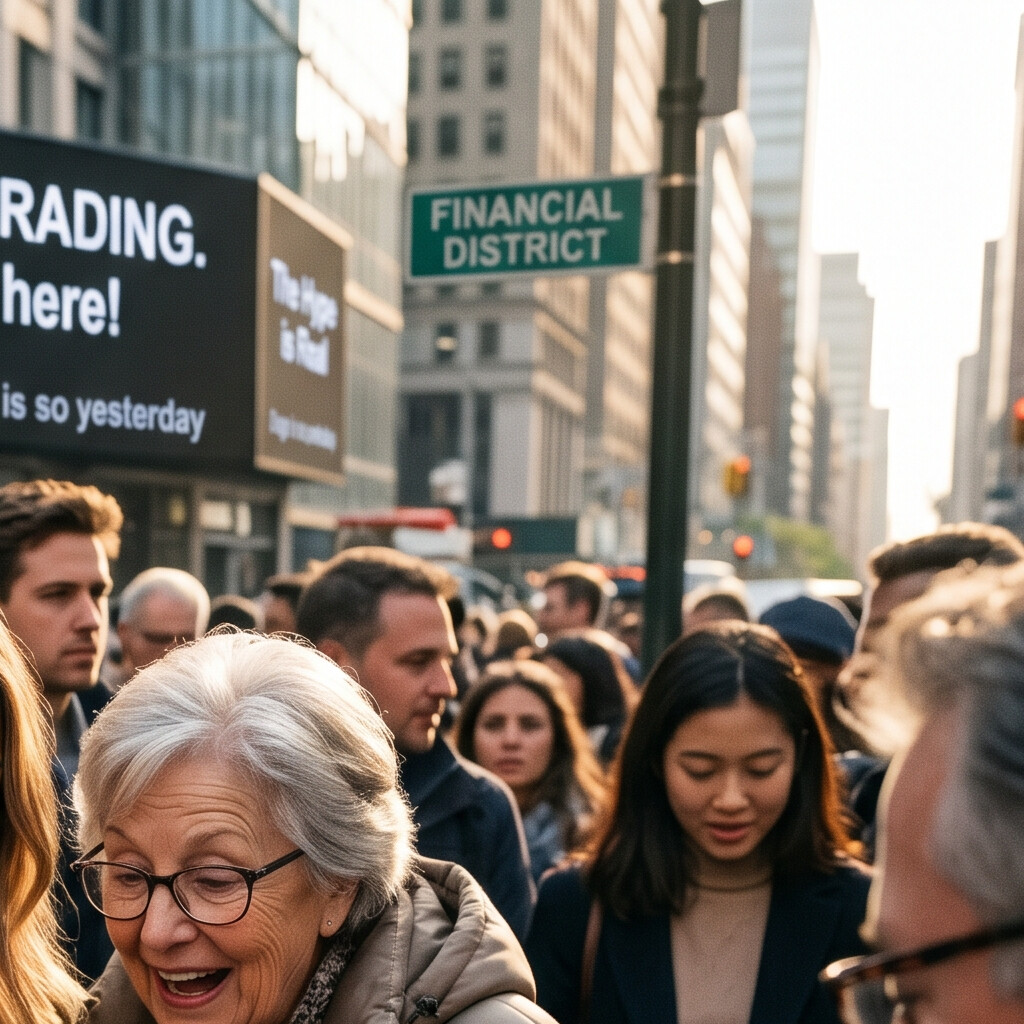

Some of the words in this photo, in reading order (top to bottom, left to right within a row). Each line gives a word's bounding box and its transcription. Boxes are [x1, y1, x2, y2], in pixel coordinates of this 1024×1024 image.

[431, 188, 623, 230] FINANCIAL
[443, 228, 607, 269] DISTRICT
[2, 260, 122, 338] here!
[2, 381, 27, 421] is
[34, 393, 71, 425] so
[75, 395, 206, 444] yesterday
